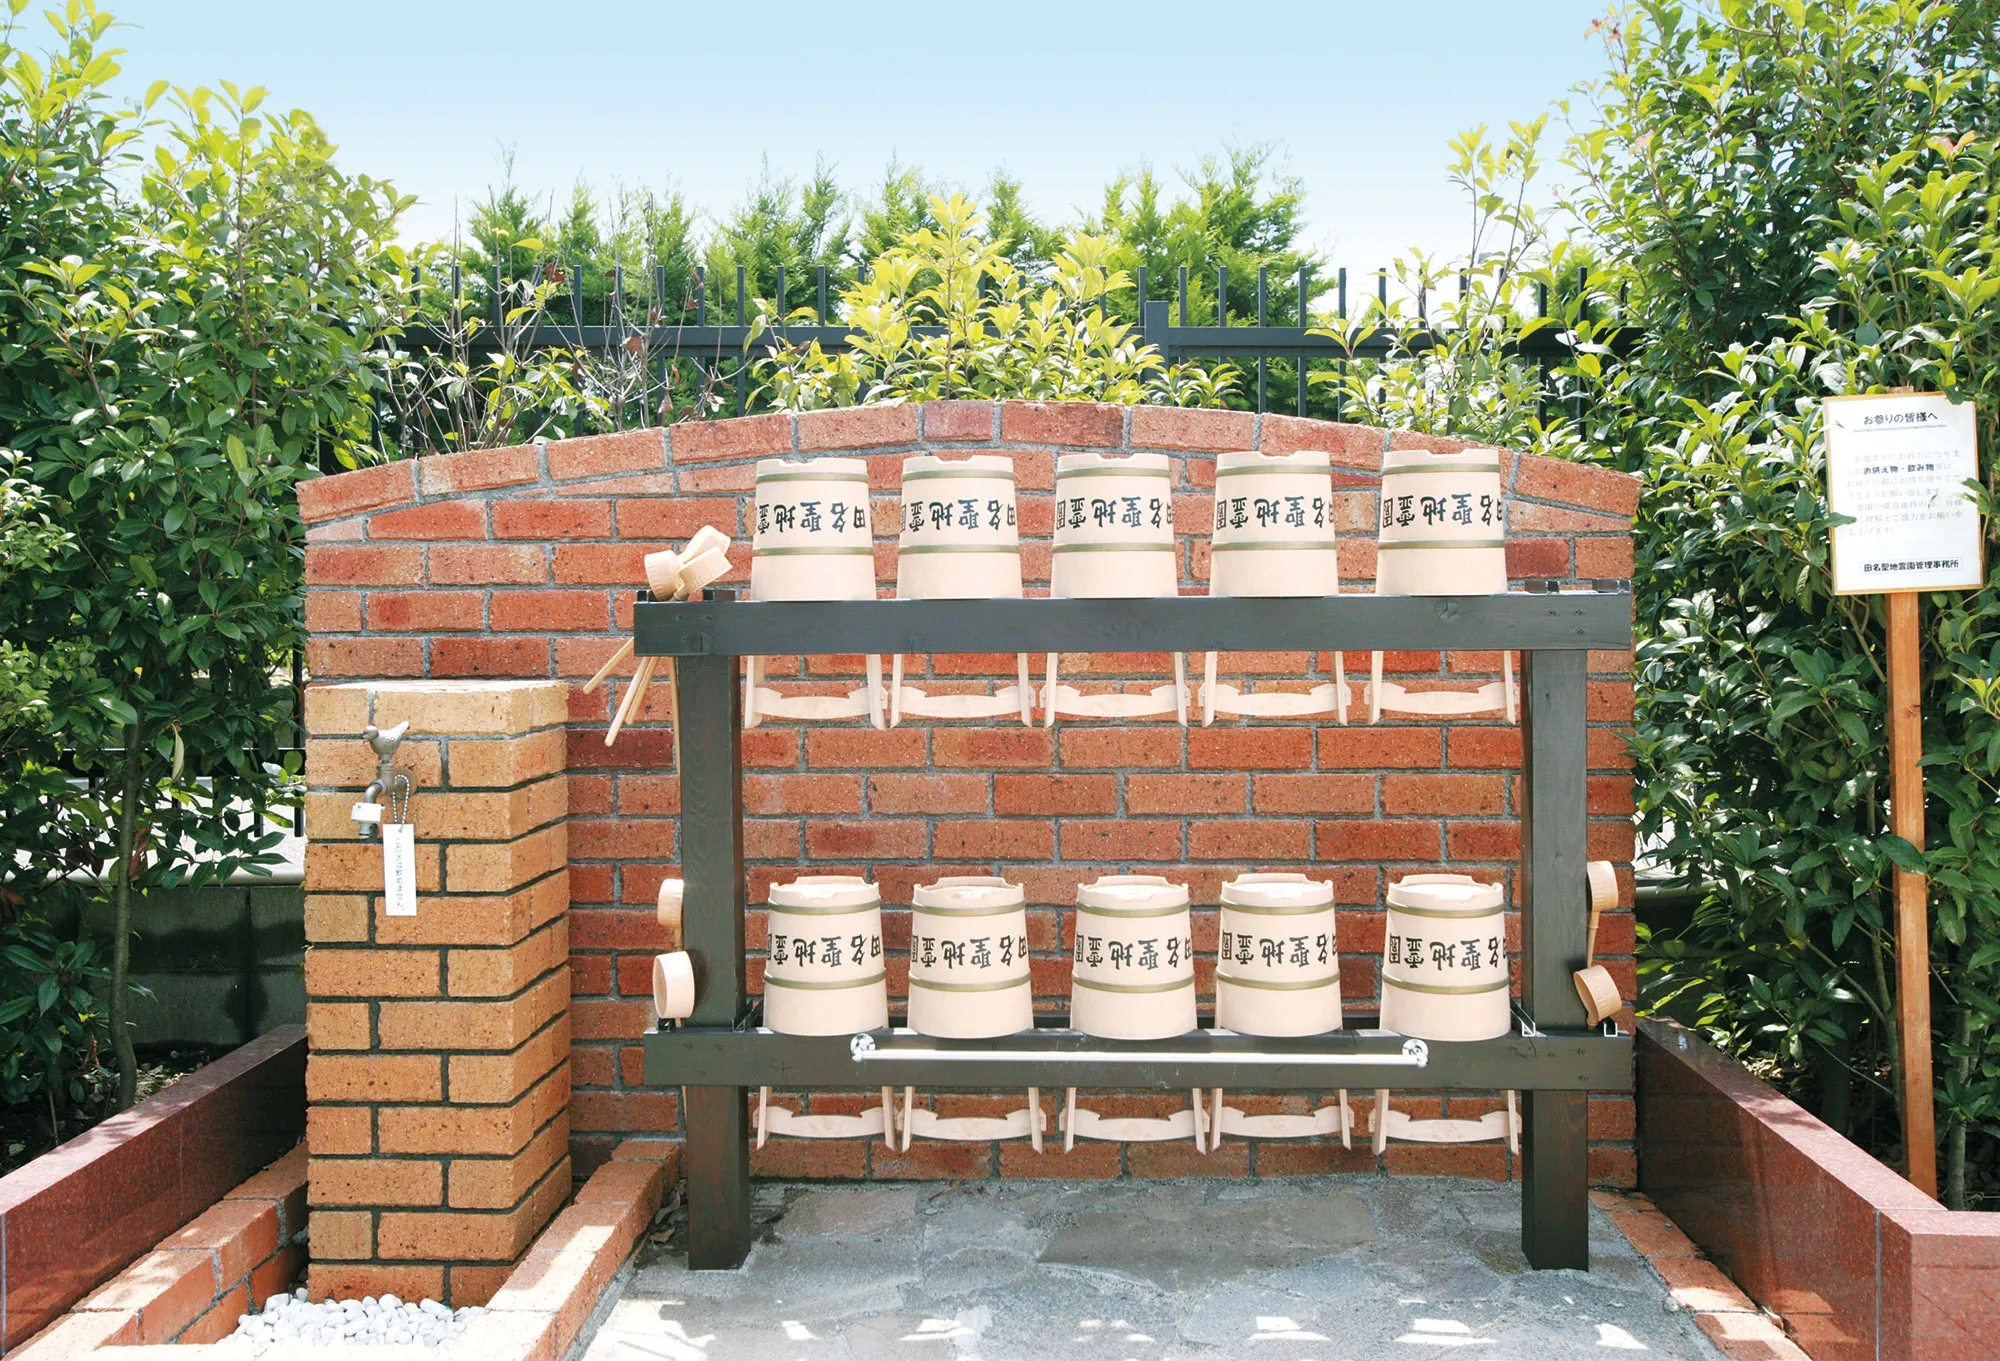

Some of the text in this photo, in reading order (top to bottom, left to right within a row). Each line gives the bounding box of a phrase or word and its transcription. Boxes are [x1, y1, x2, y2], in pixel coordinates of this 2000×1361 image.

[1863, 411, 1938, 425] お参りの皆様へ
[755, 500, 867, 533] 田名聖地霊
